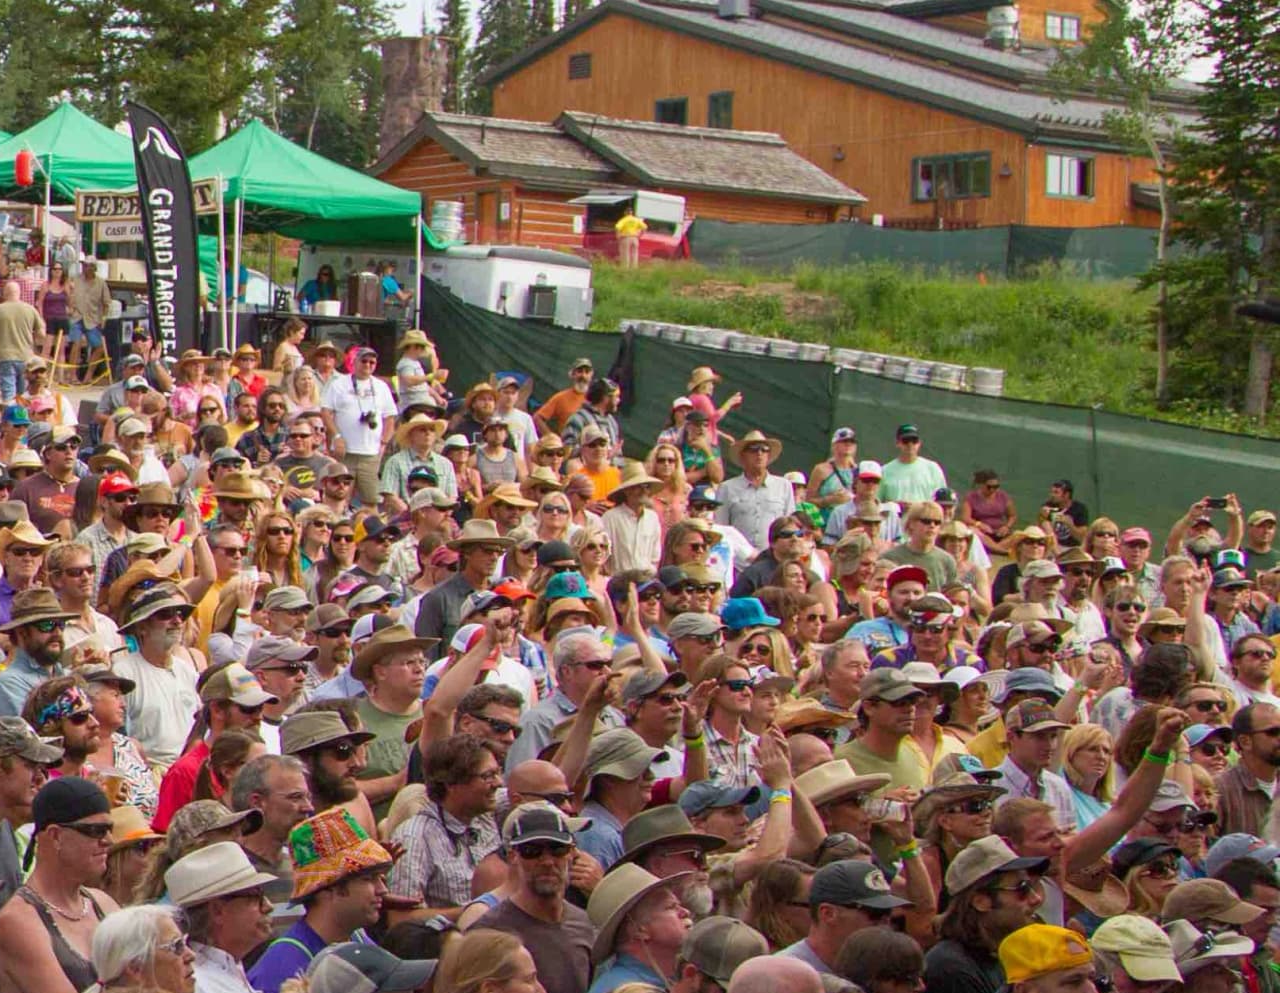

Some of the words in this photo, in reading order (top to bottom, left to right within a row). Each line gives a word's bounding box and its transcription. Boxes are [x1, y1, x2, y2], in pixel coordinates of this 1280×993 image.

[105, 225, 126, 236] CASH
[148, 188, 175, 264] GRAND
[151, 264, 178, 355] TARGHEE
